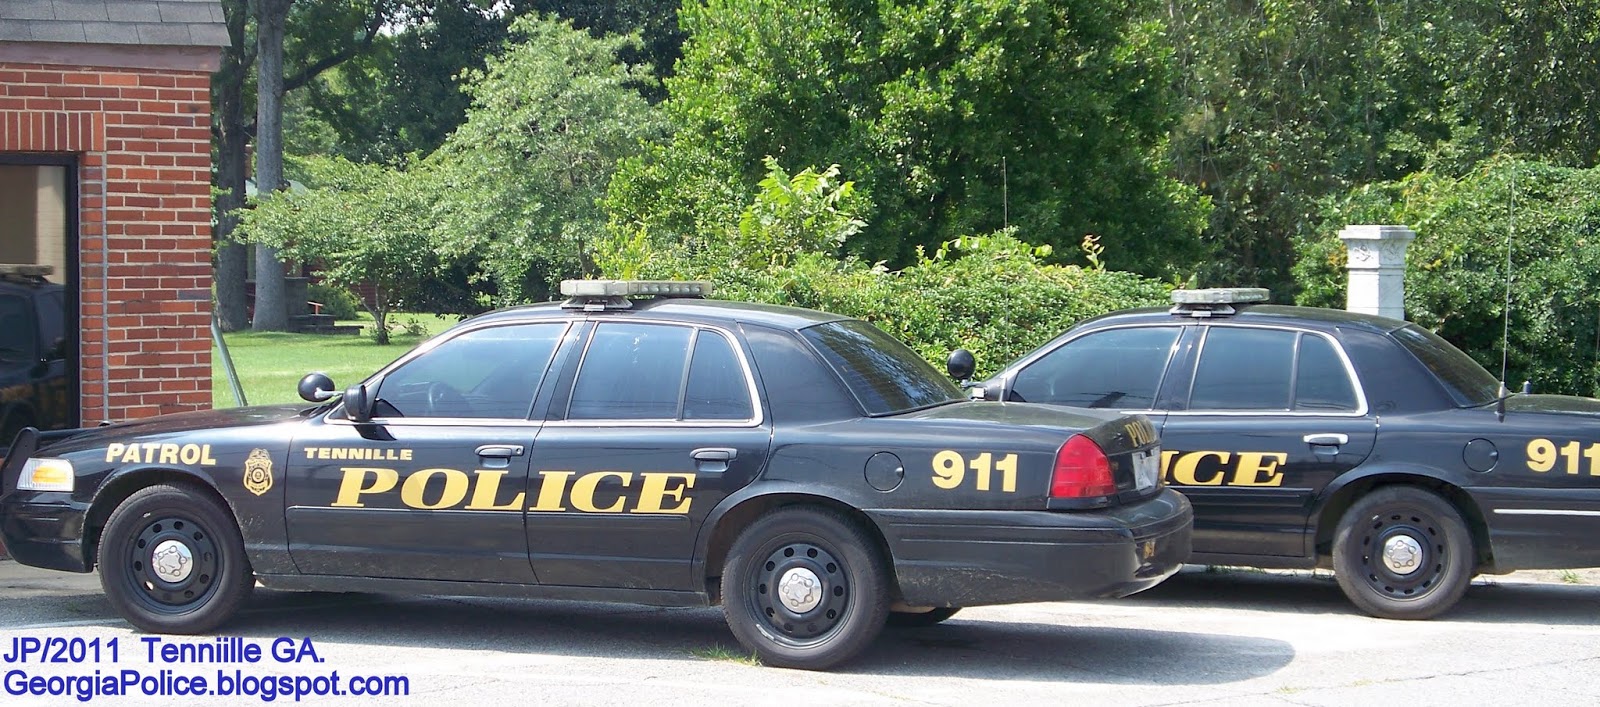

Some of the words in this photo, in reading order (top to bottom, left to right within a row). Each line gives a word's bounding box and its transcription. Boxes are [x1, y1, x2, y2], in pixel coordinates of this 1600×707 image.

[106, 443, 216, 465] PATROL
[304, 447, 412, 461] TENNILLE
[932, 450, 1018, 492] 911
[1527, 438, 1600, 476] 911
[331, 467, 696, 514] POLICE
